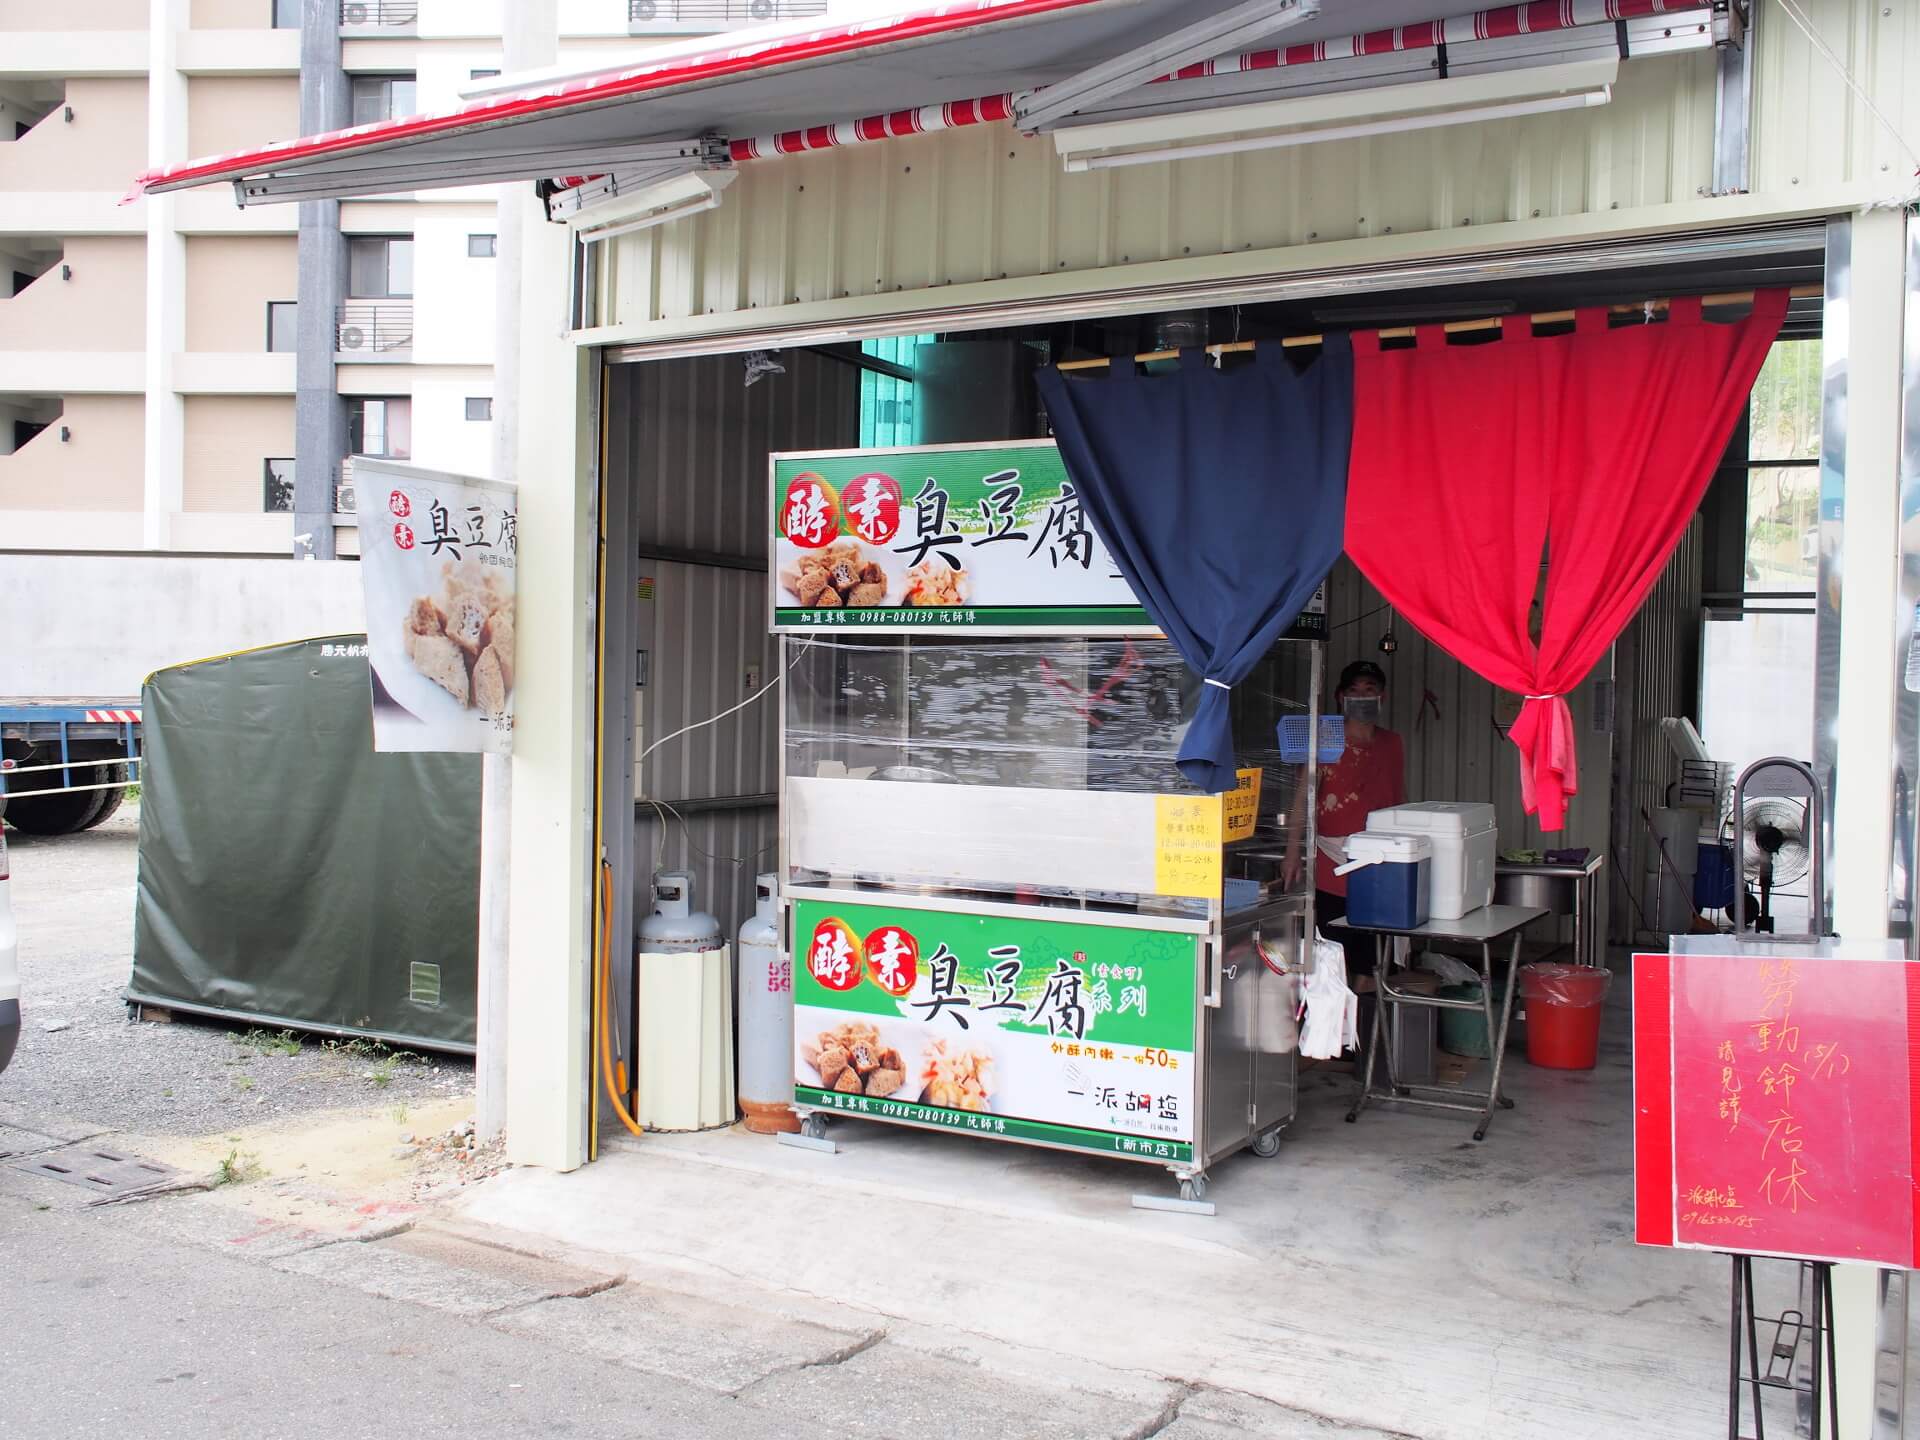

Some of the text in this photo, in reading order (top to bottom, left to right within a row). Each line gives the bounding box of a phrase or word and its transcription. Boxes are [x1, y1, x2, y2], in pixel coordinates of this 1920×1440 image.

[420, 497, 518, 562] 臭豆腐
[786, 470, 1095, 572] 酵素 臭豆腐
[811, 929, 913, 989] 酵素
[910, 943, 1086, 1041] 臭豆腐
[1091, 980, 1148, 1018] 系列
